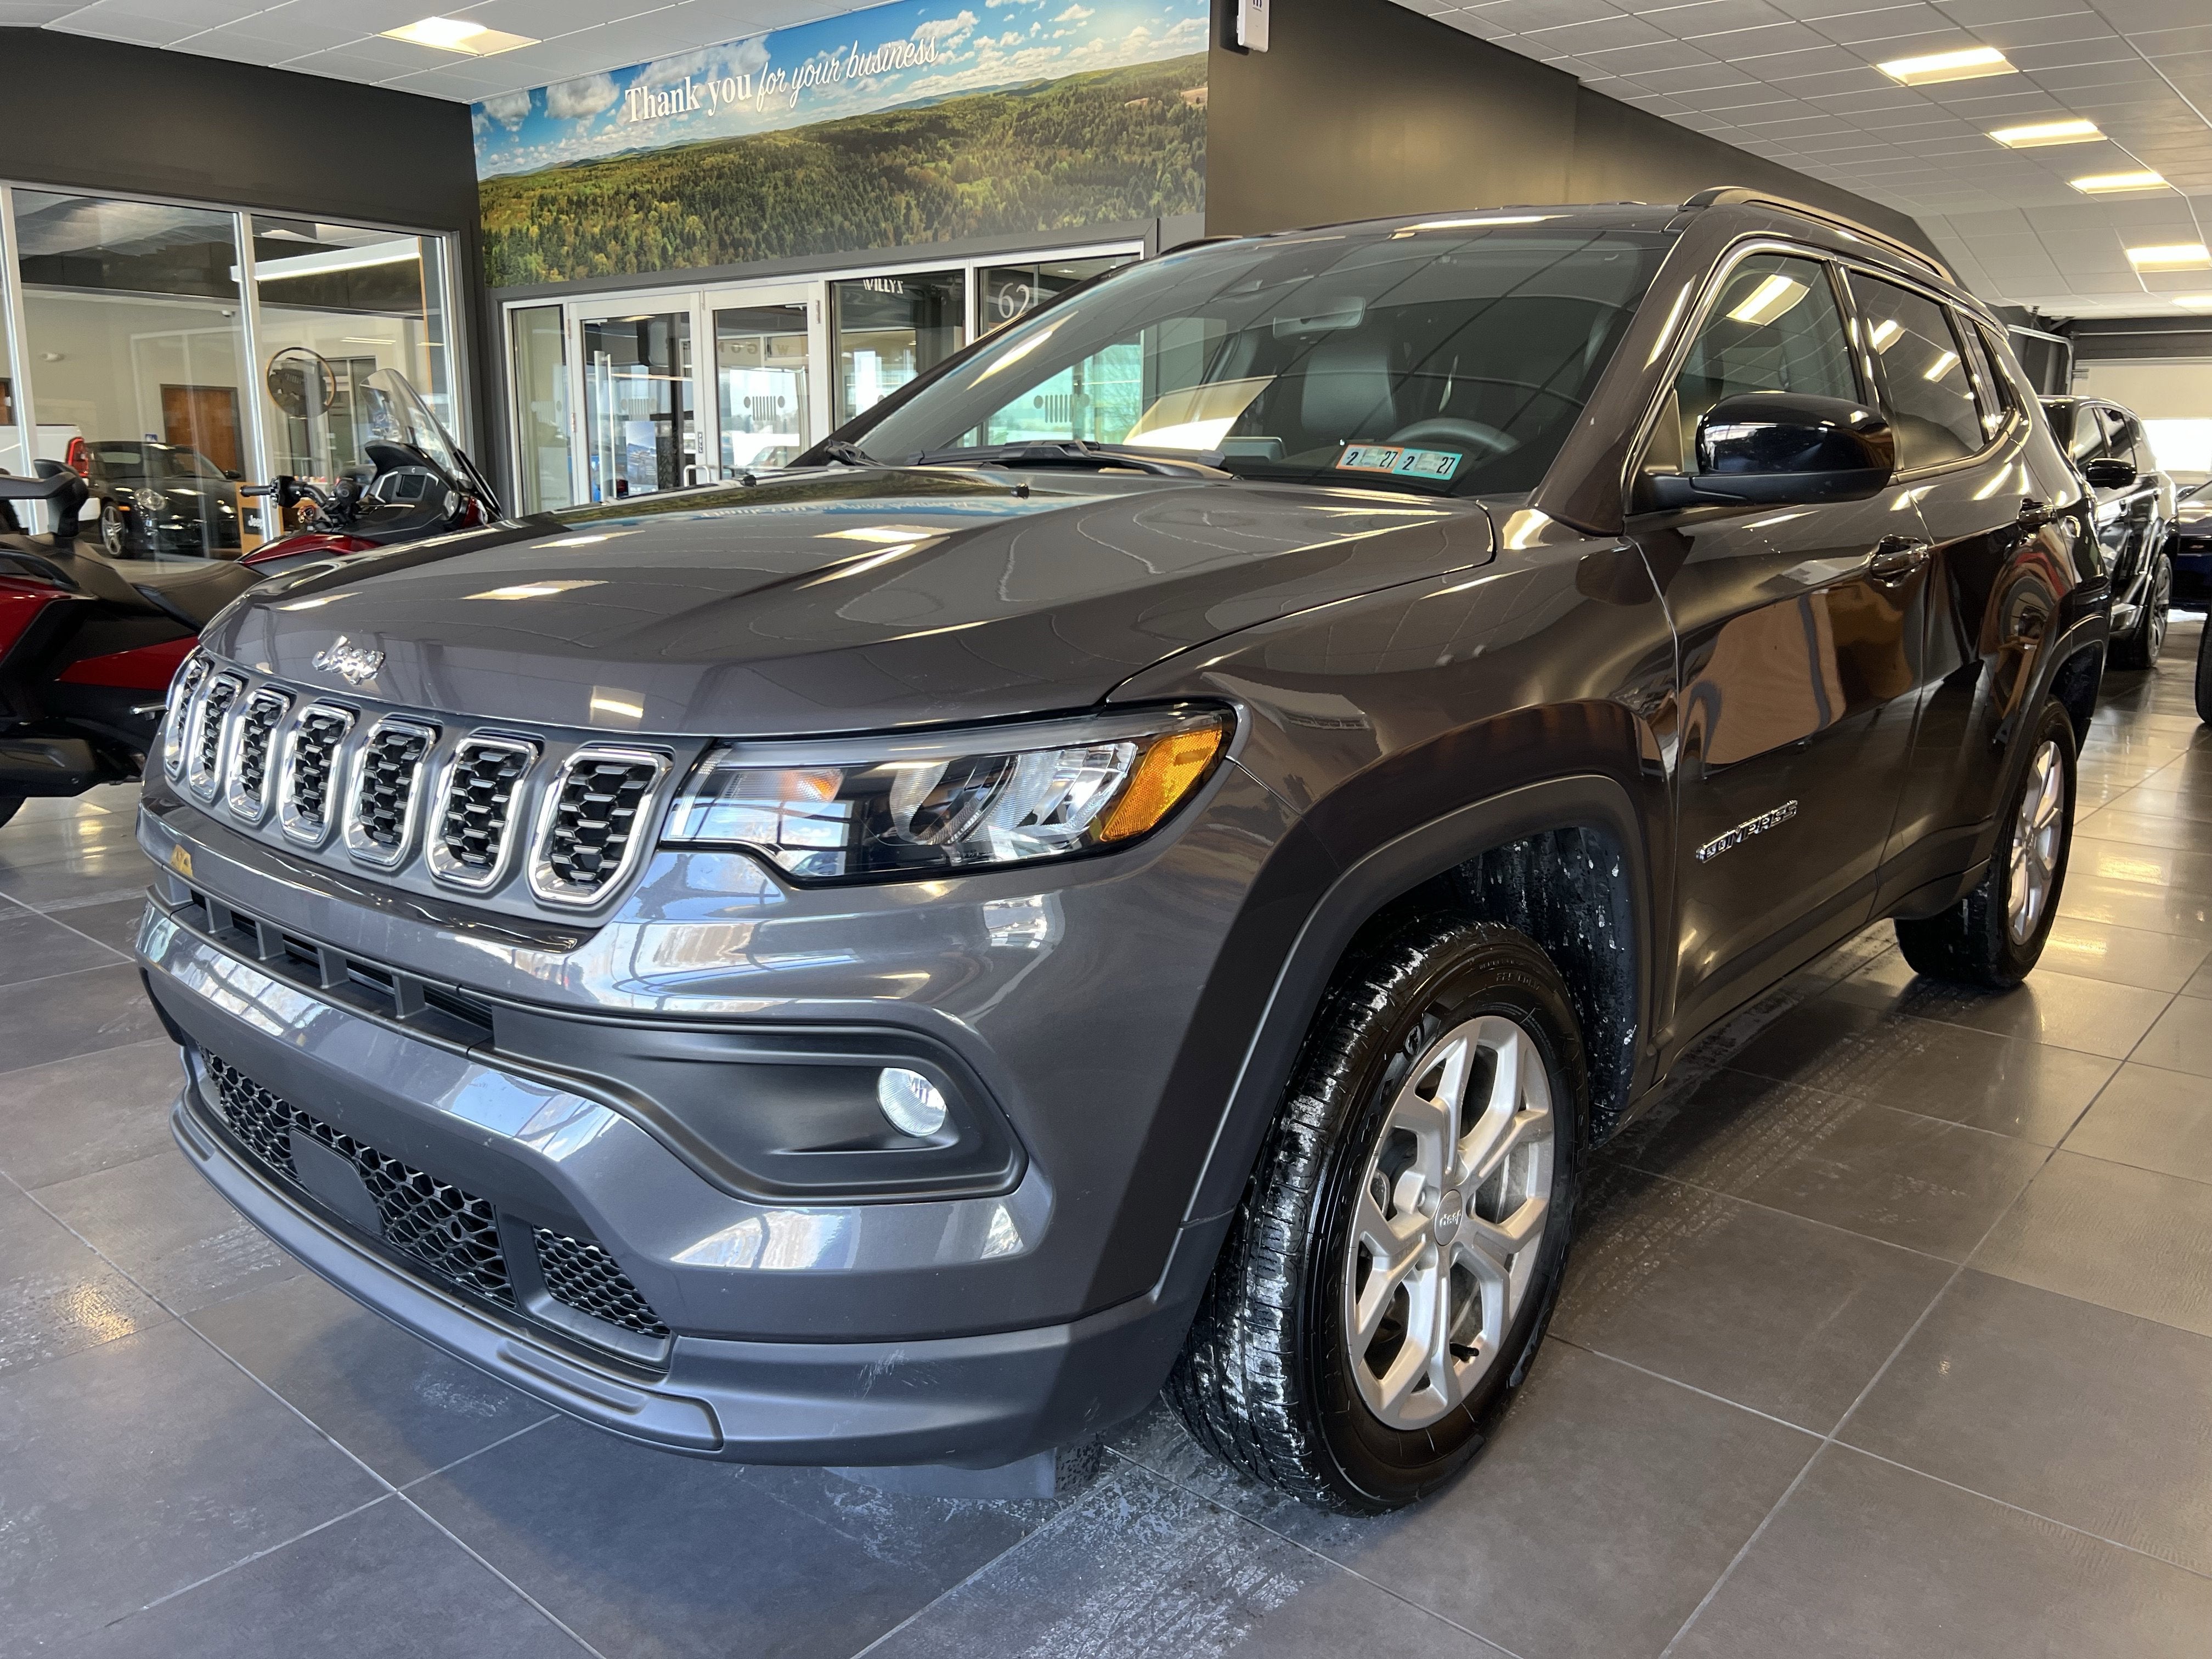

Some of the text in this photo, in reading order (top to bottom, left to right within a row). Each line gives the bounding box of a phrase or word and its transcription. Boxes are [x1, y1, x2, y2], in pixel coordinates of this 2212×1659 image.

[625, 36, 939, 122] Thank you for your business
[863, 278, 904, 294] WILLYS
[1346, 450, 1398, 470] 2 27
[1402, 456, 1455, 475] 2 27
[312, 635, 386, 685] Jeep
[1440, 1209, 1462, 1228] Jeep
